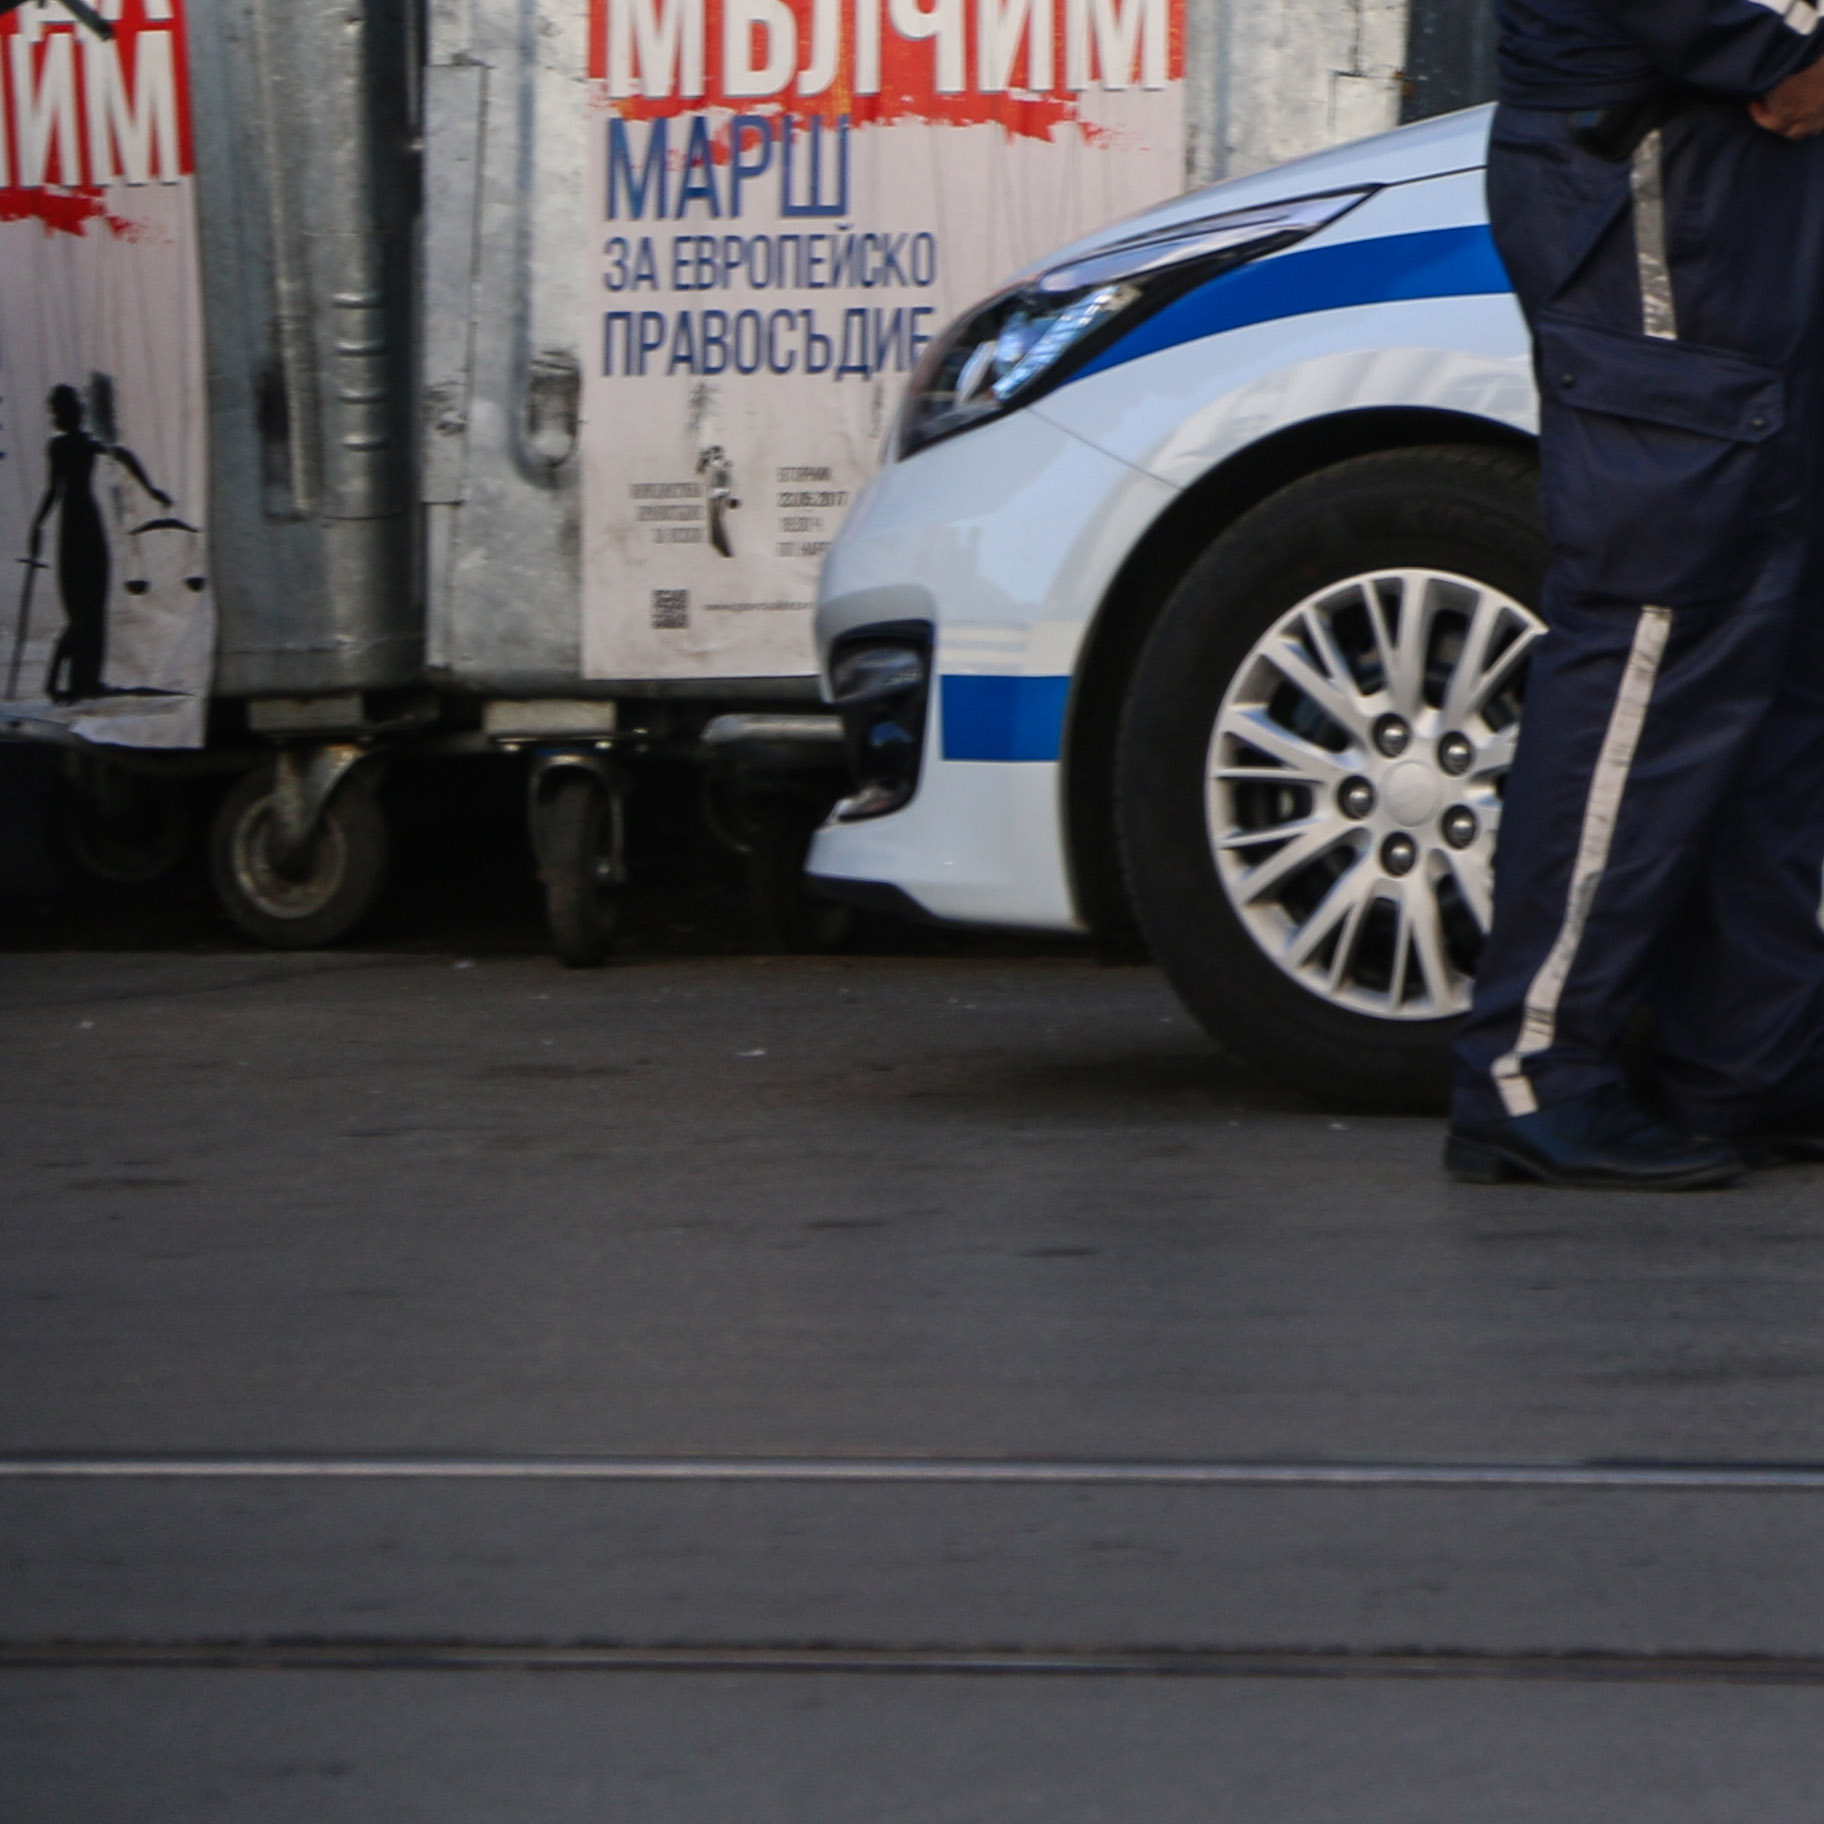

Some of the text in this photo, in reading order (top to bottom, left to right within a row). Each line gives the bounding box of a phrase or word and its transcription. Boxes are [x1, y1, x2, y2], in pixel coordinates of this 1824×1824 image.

[0, 29, 182, 189] ИМ
[606, 113, 850, 221] МАРШ
[604, 222, 938, 292] ЗА ЕВРОПЕЙСКО
[604, 306, 937, 381] ПРАВОСЪДИЕ
